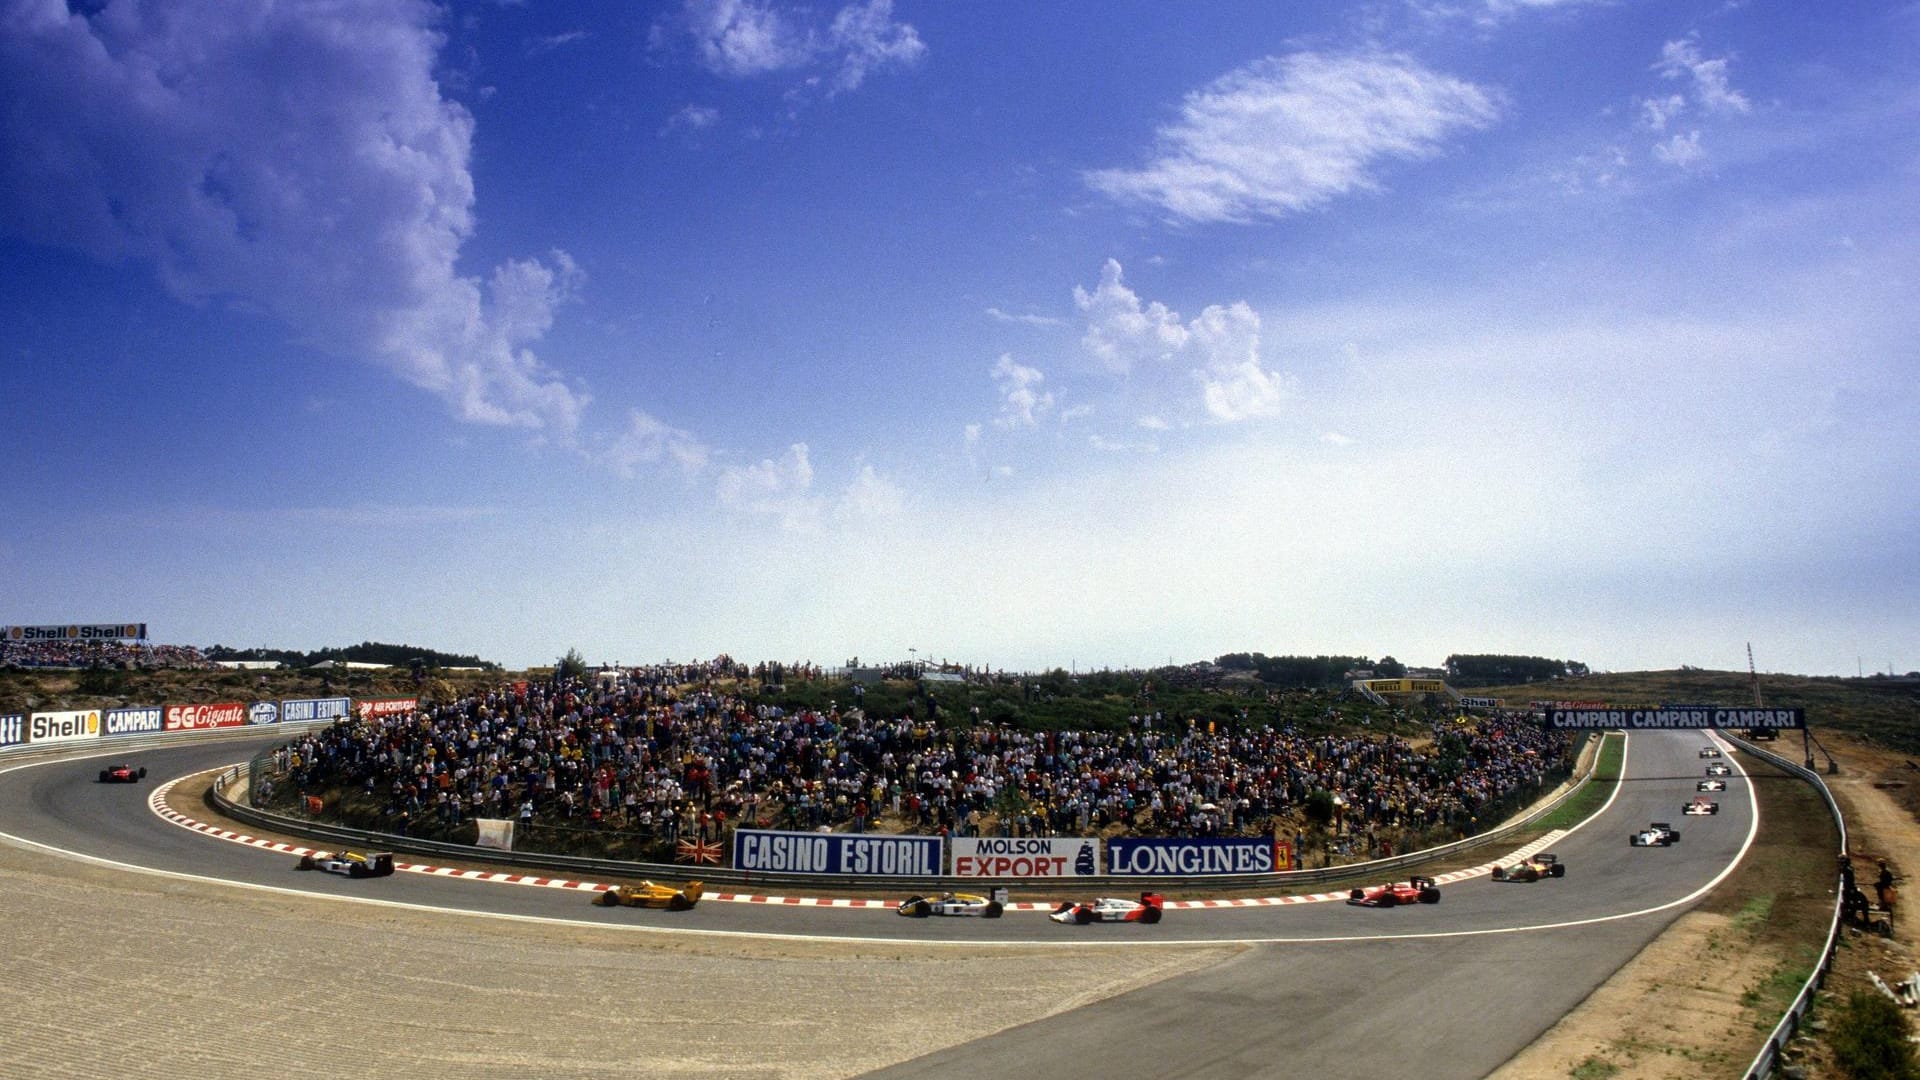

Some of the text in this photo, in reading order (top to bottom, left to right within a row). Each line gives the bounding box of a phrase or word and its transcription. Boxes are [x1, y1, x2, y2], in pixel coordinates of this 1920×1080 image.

[24, 626, 124, 638] Shell Shell
[285, 700, 347, 721] CASINO ESTORIL
[385, 700, 416, 711] PORTUGAL
[1461, 698, 1496, 707] Shell
[33, 715, 85, 739] Shell
[107, 710, 160, 734] CAMPARI
[167, 705, 243, 729] SG Gigante
[1553, 711, 1796, 727] CAMPARI CAMPARI CAMPARI
[743, 835, 932, 874] CASINO ESTORIL
[976, 839, 1051, 854] MOLSON
[956, 856, 1067, 876] EXPORT
[1111, 844, 1272, 874] LONGINES
